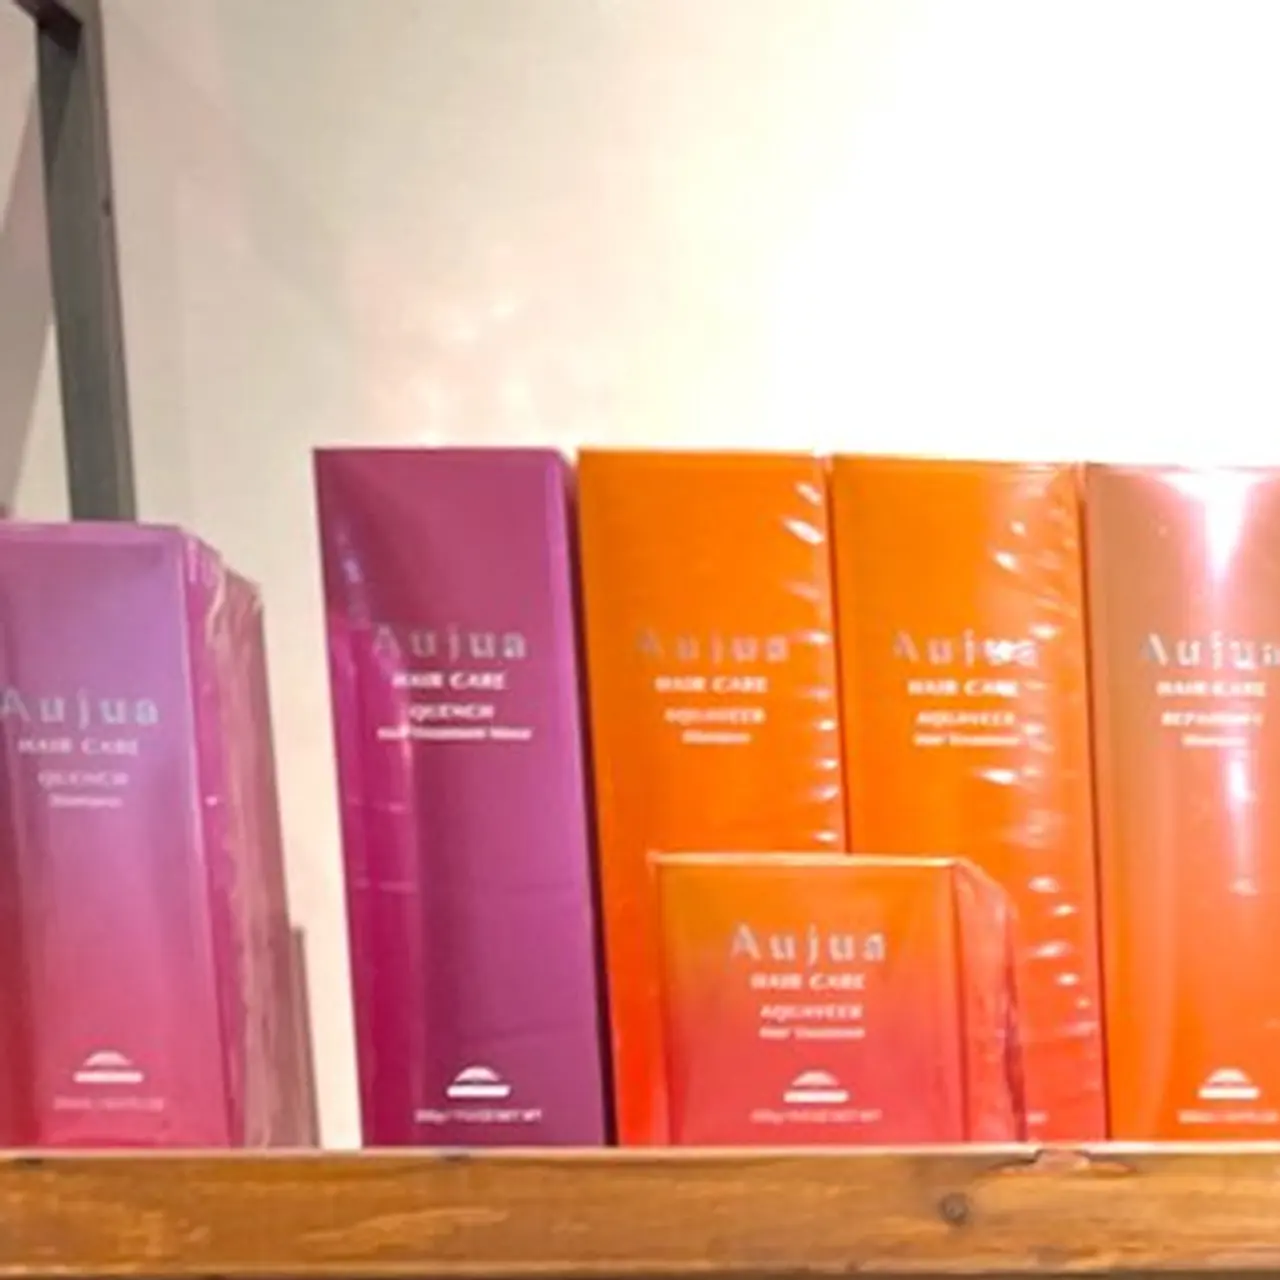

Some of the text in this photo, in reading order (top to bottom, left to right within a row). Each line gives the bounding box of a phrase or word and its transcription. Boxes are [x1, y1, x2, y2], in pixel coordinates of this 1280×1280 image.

[372, 624, 526, 663] Aujua
[637, 627, 790, 667] Aujua
[449, 671, 507, 690] CARE
[711, 676, 769, 694] CARE
[0, 689, 159, 731] Aujua
[731, 923, 886, 965] Aujua
[809, 973, 866, 990] CARE
